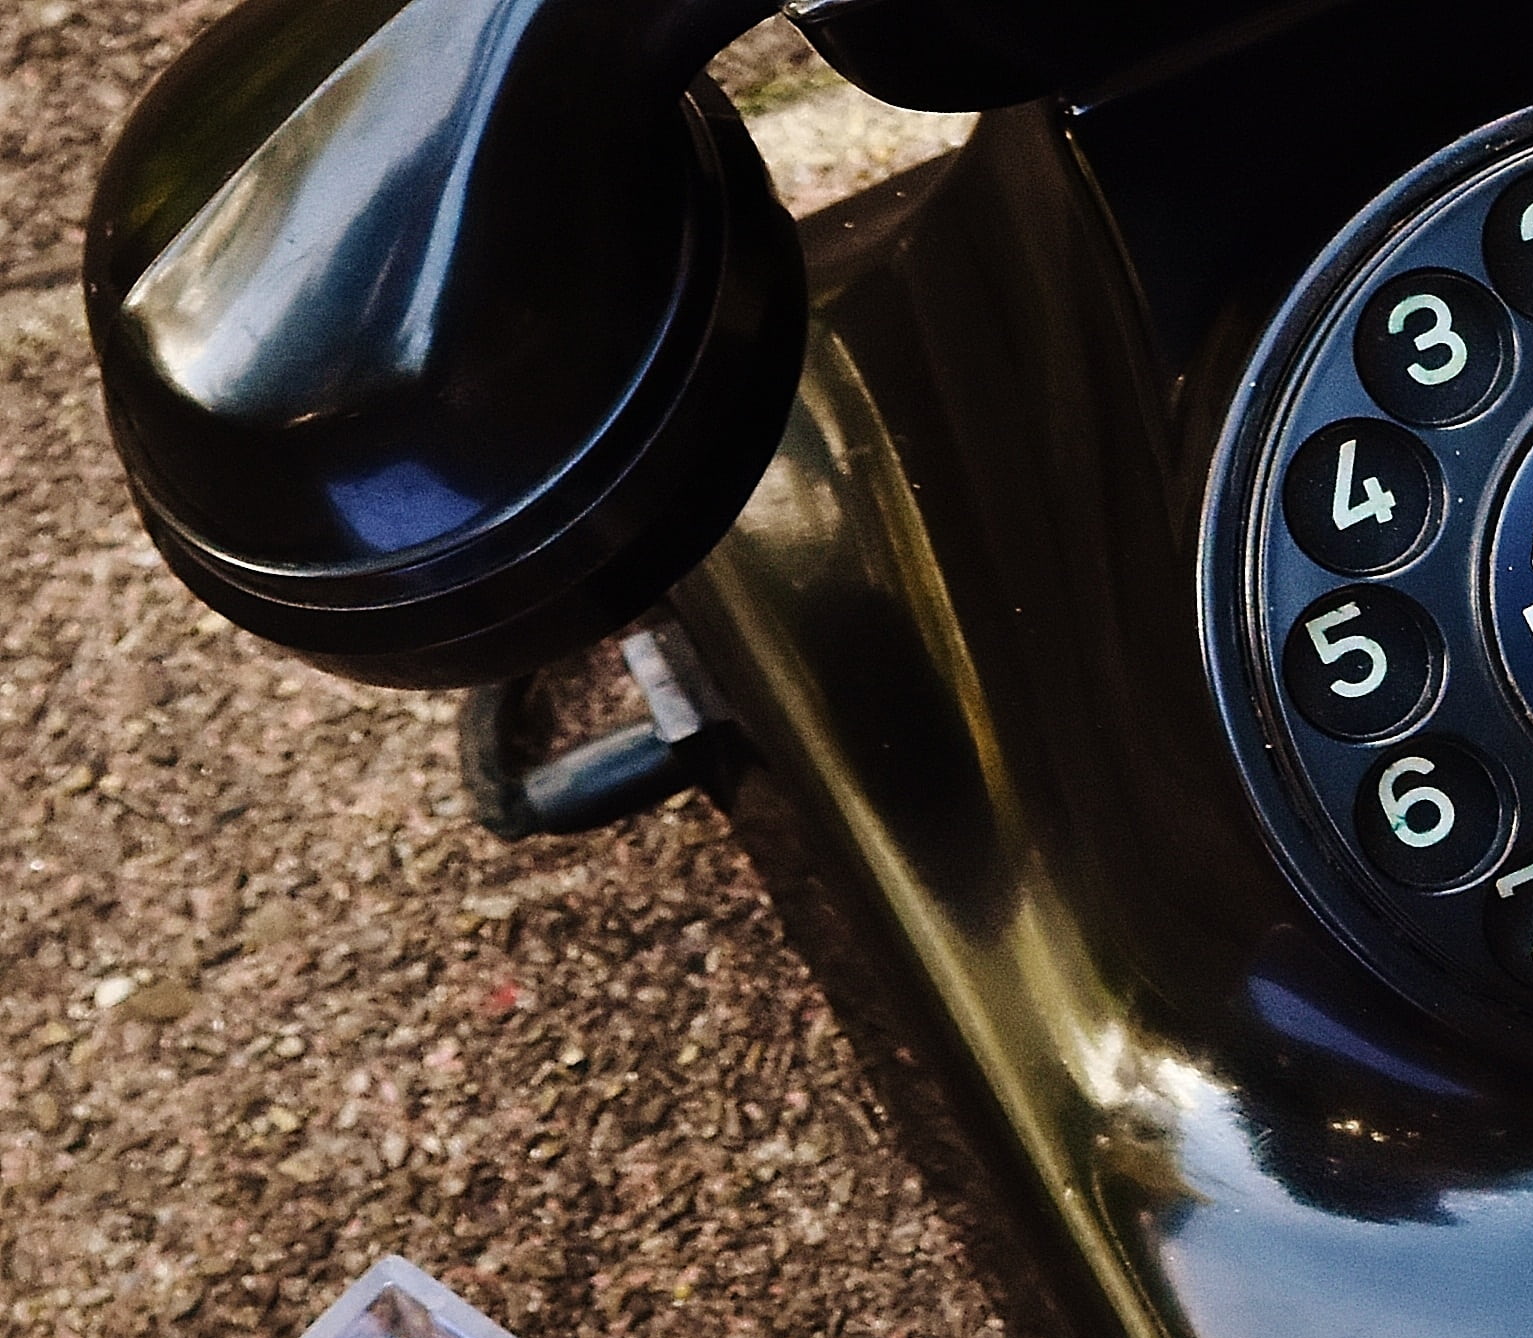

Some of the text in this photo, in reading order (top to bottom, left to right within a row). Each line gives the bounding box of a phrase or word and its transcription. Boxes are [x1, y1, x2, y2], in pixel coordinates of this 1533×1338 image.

[1388, 294, 1467, 385] 3
[1333, 440, 1396, 530] 4
[1305, 602, 1387, 697] 5
[1379, 757, 1455, 847] 6
